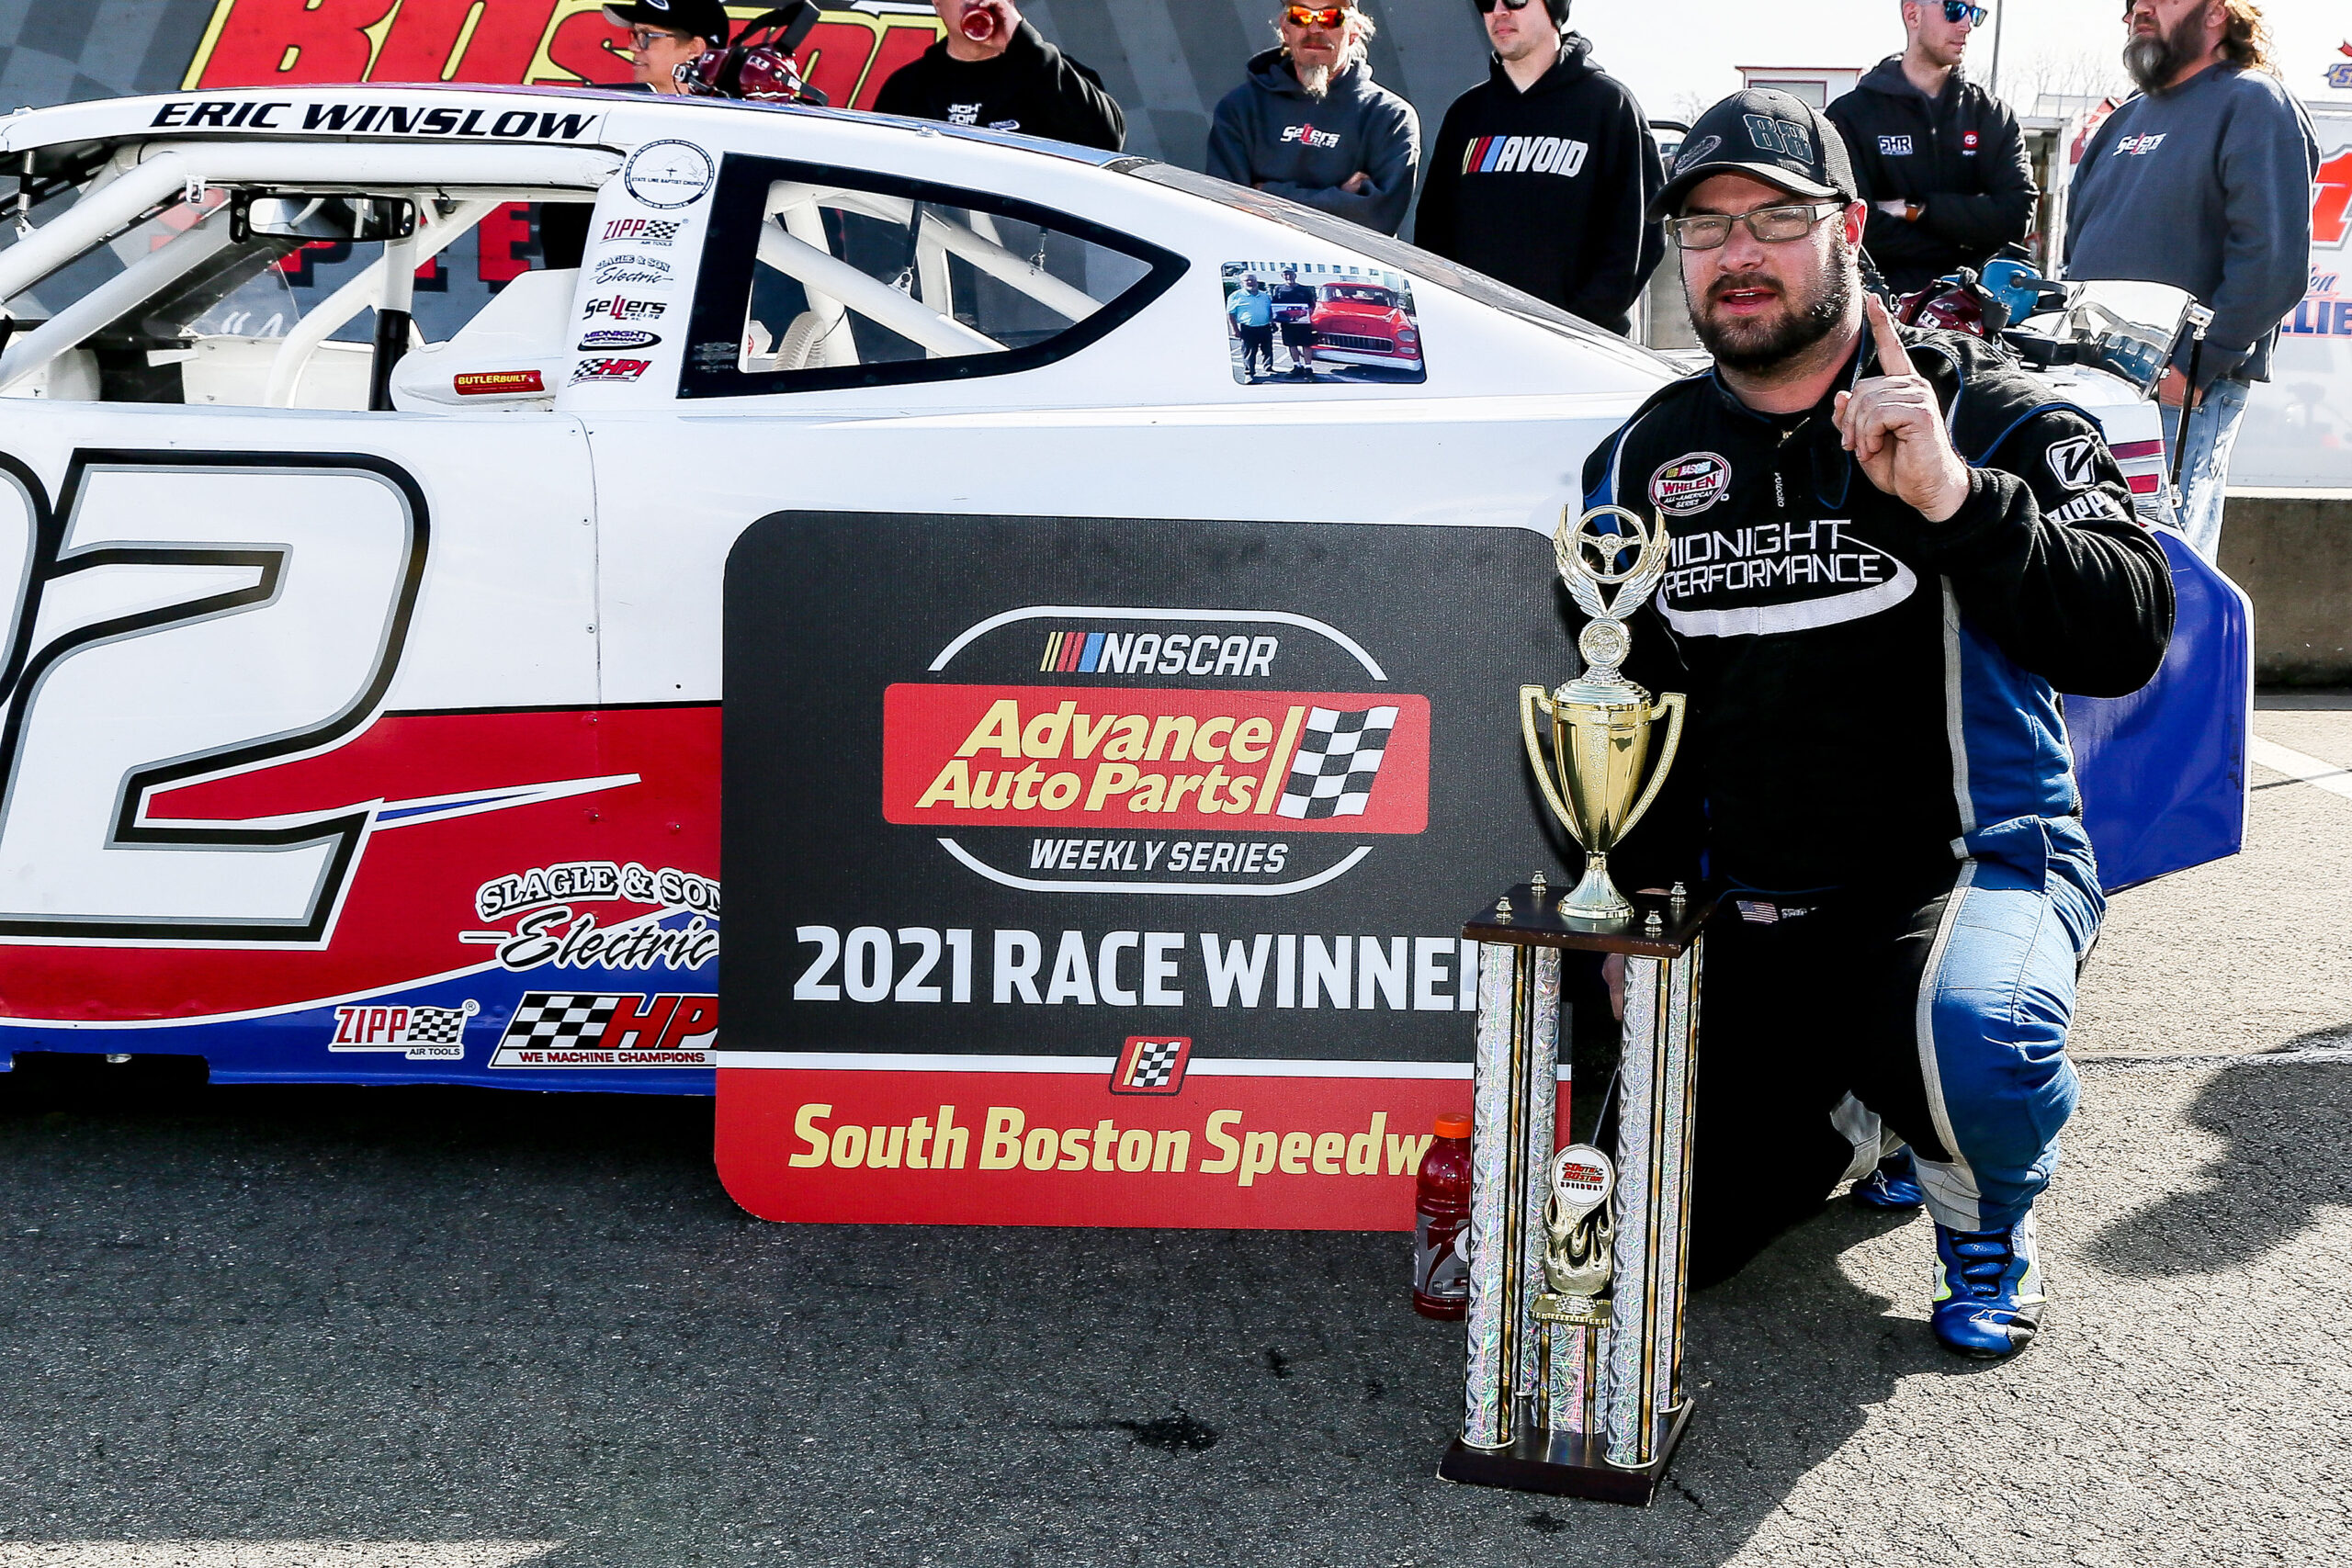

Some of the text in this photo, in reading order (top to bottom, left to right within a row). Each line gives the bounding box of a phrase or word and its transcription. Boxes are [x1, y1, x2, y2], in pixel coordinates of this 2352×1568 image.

[149, 102, 599, 139] ERIC WINSLOW
[1743, 113, 1815, 165] 88
[1494, 136, 1589, 177] AVOID
[603, 219, 647, 241] ZIPP
[595, 266, 663, 285] Electric
[647, 257, 671, 273] SON
[582, 295, 668, 321] Sellers
[458, 374, 527, 385] BUTLERBUILT
[595, 358, 653, 377] HPI
[1662, 473, 1717, 496] WHELEN
[1664, 554, 1883, 600] PERFORMANCE
[1098, 632, 1280, 677] NASCAR
[0, 446, 430, 942] 2
[953, 699, 1273, 763] Advance
[914, 759, 1259, 816] Auto Parts
[1030, 838, 1289, 874] WEEKLY SERIES
[481, 865, 618, 917] SLAGLE
[624, 866, 654, 897] &
[501, 909, 718, 966] Electric
[793, 925, 975, 1003] 2021
[993, 930, 1186, 1009] RACE
[336, 1009, 408, 1043] ZIPP
[597, 996, 719, 1049] HP
[518, 1052, 706, 1064] WE MACHINE CHAMPIONS
[788, 1103, 1434, 1187] South Boston Speedw
[1560, 1181, 1603, 1191] SPEEDWAY
